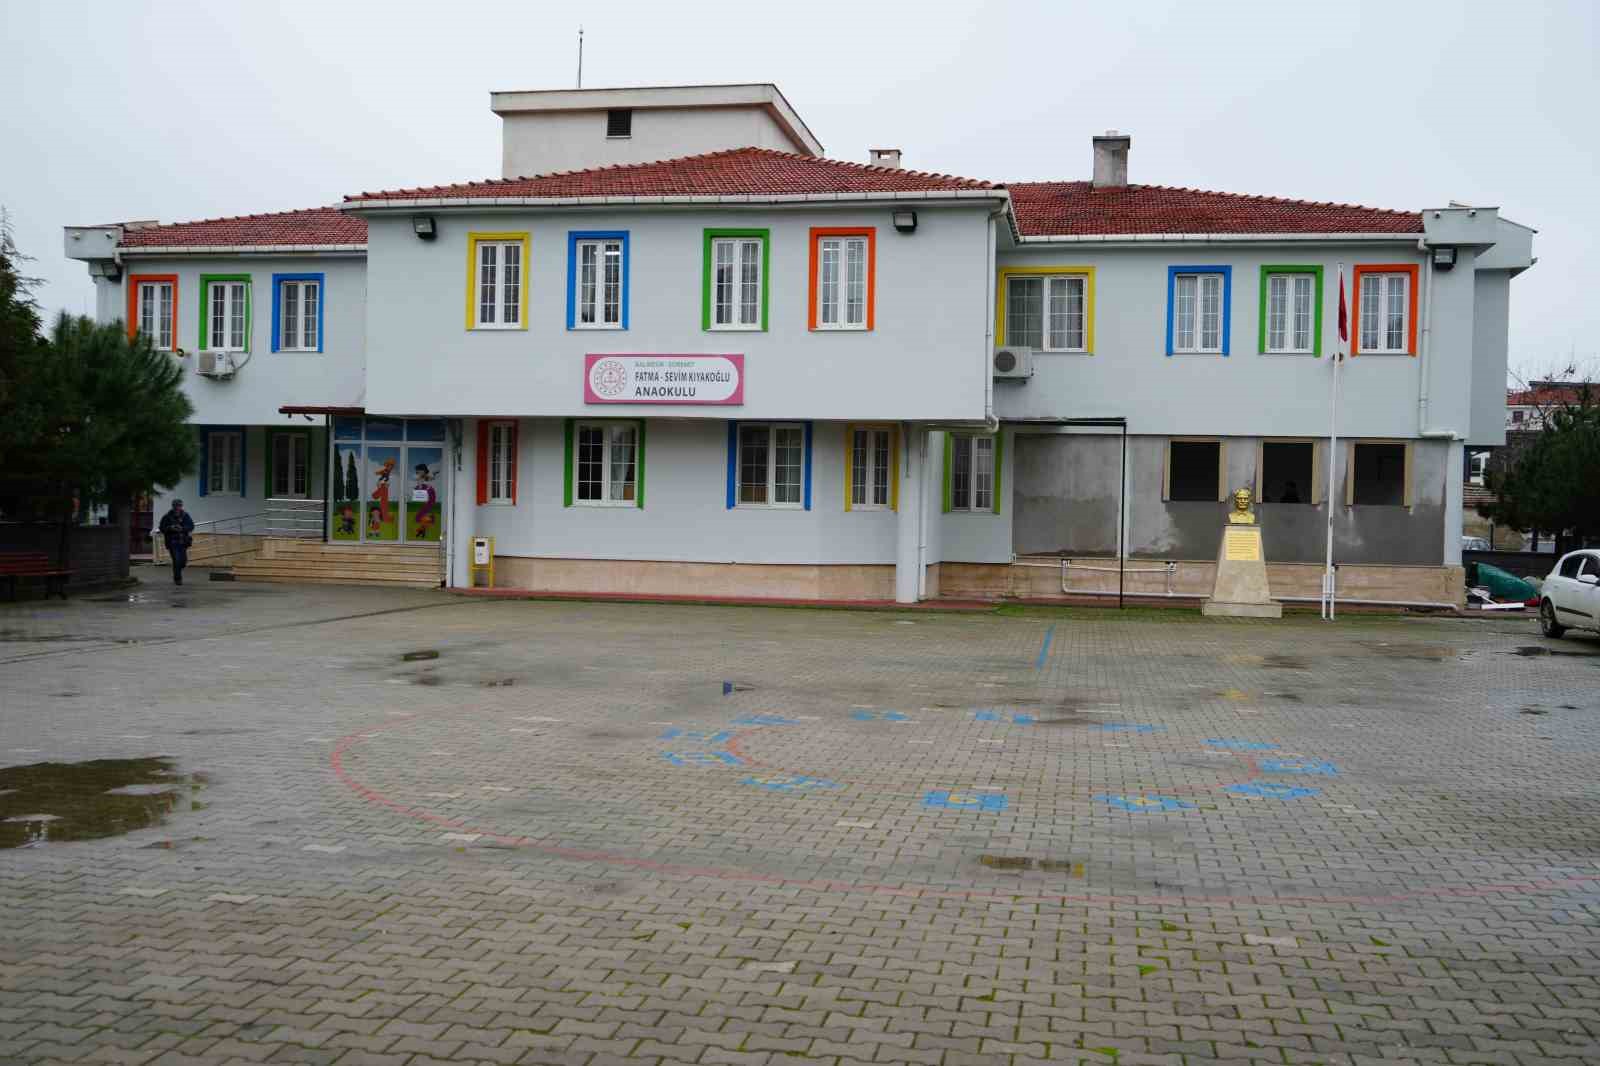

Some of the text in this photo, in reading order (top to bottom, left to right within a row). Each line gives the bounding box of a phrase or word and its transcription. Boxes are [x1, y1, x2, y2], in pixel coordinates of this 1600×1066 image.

[635, 371, 659, 382] FATMA
[689, 370, 730, 382] KIYAKOĞLU
[635, 386, 696, 397] ANAOKULU
